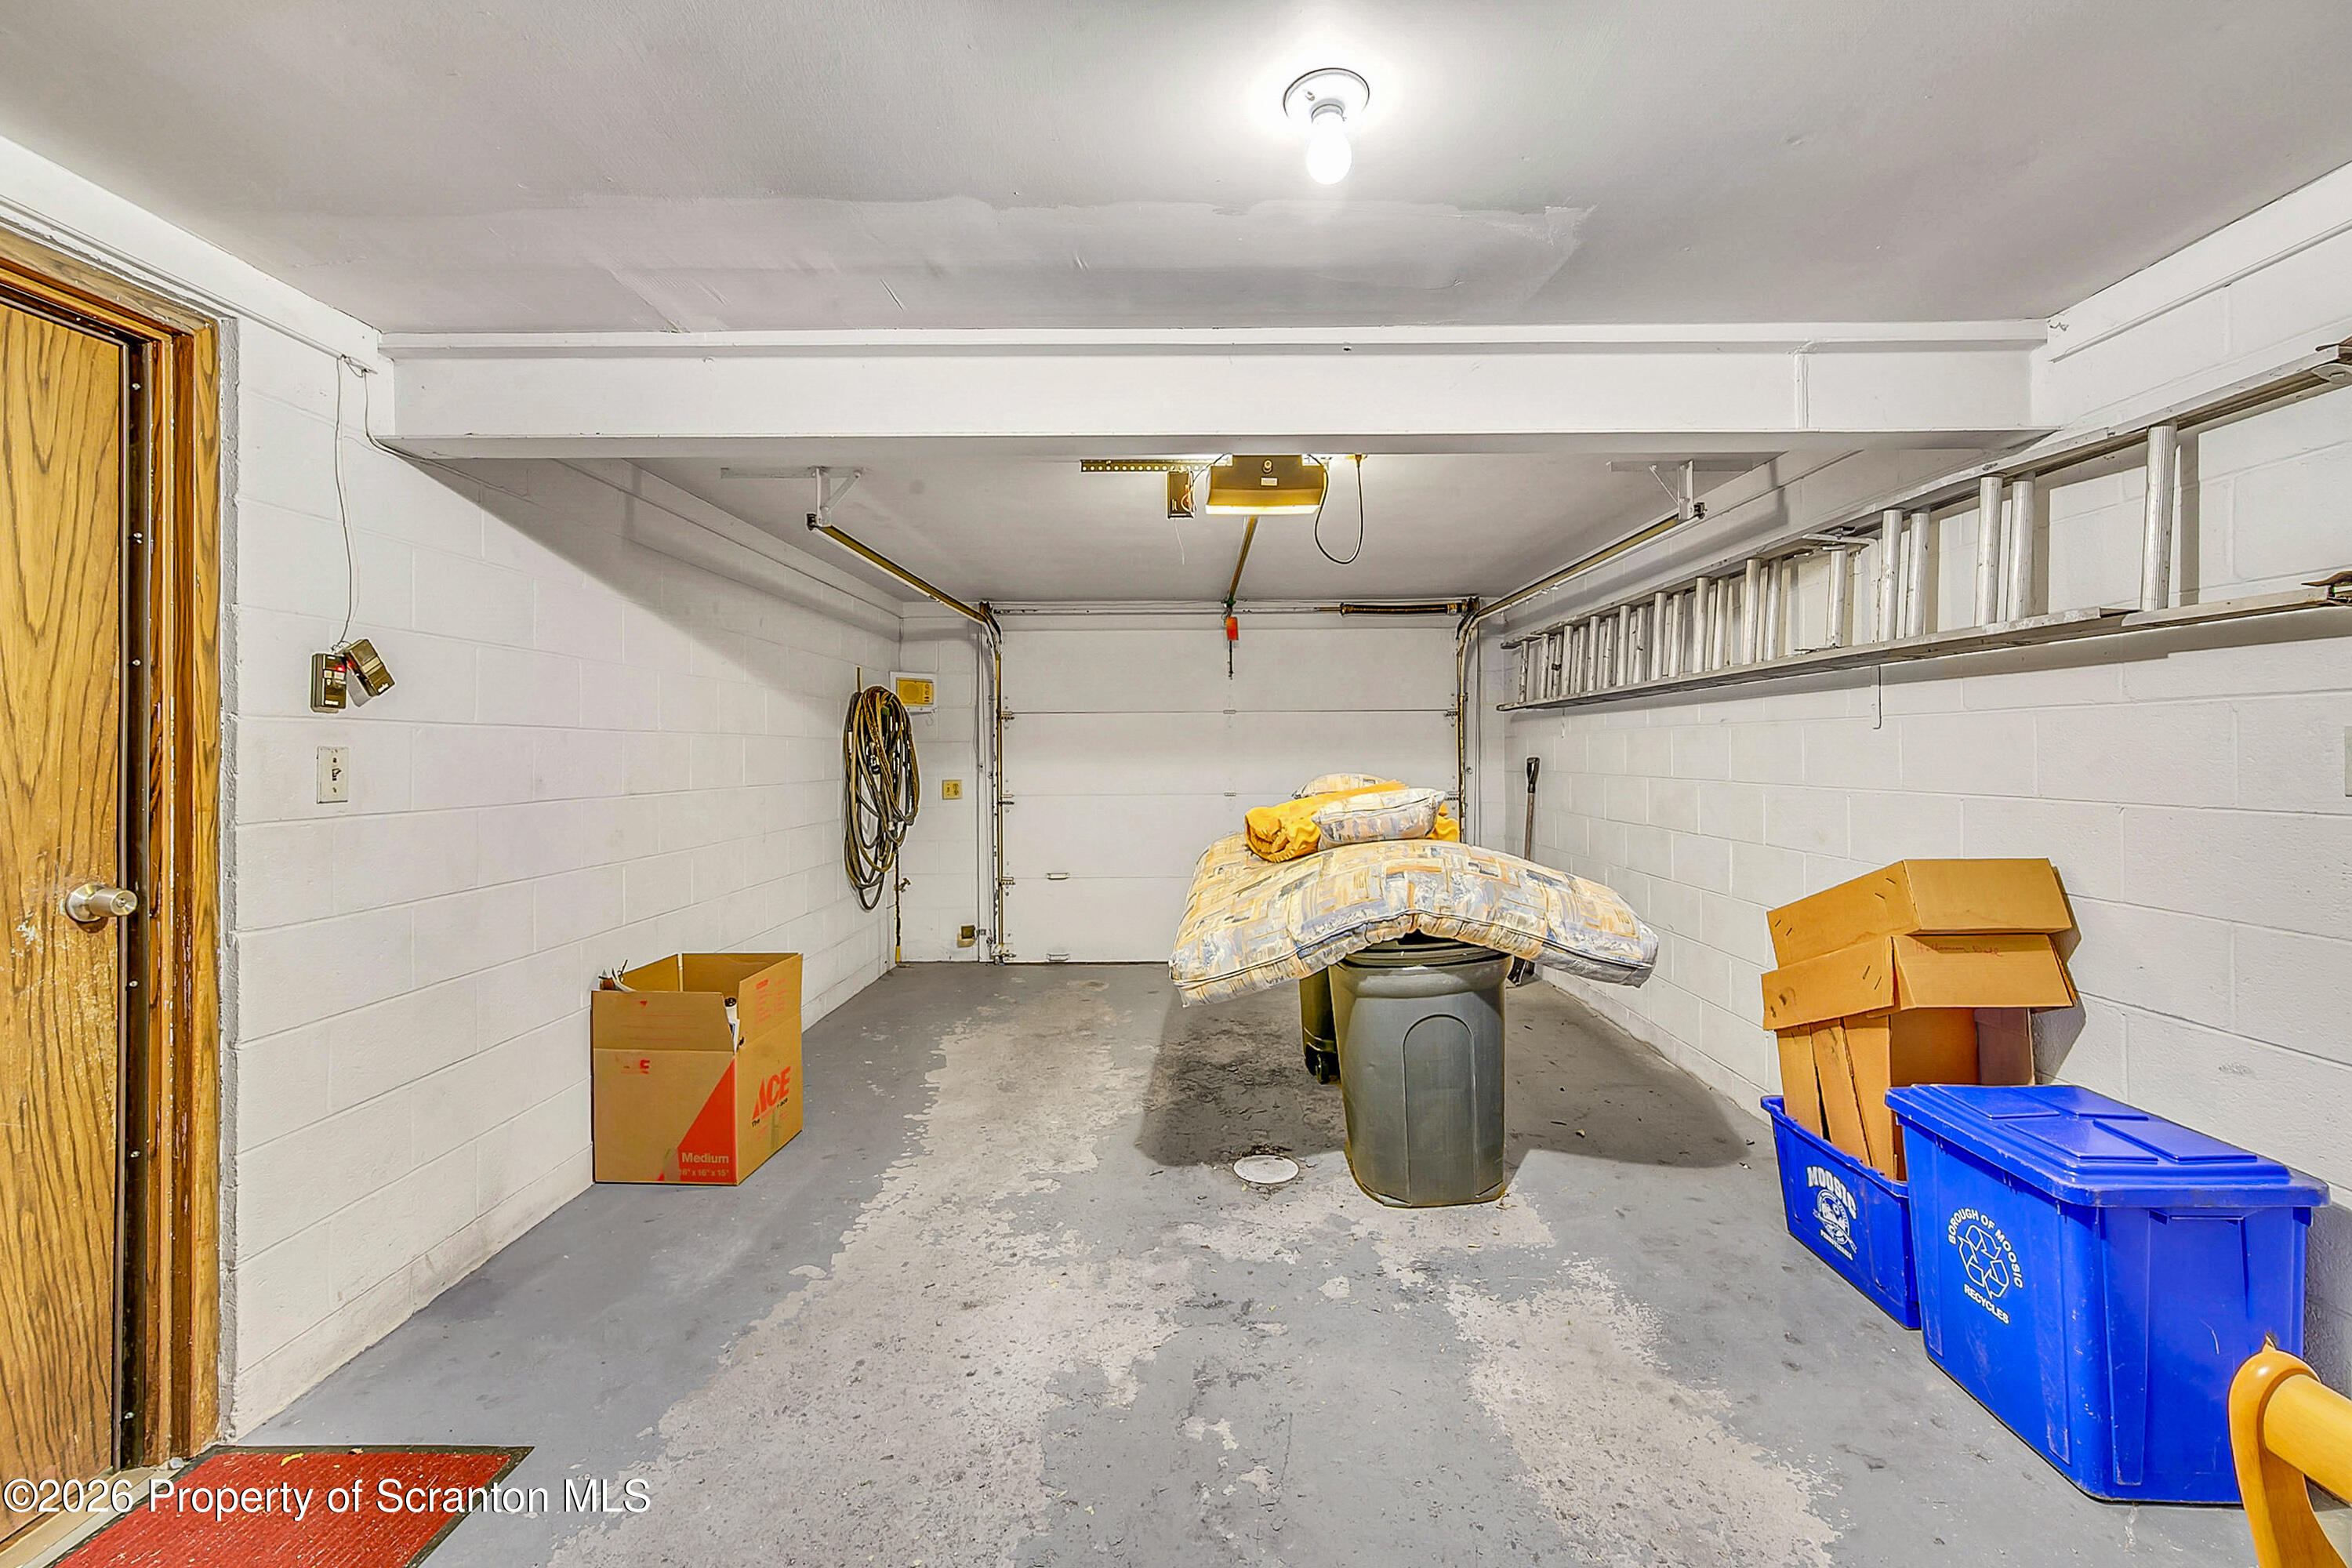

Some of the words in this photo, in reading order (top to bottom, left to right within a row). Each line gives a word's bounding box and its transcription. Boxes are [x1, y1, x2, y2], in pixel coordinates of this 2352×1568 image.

[751, 1065, 792, 1121] ACE
[681, 1152, 730, 1164] Medium
[1806, 1166, 1858, 1220] MOOSIC
[1947, 1207, 1980, 1246] BOROUGH
[1980, 1214, 1995, 1230] OF
[1994, 1229, 2024, 1289] MOOSIC
[1963, 1283, 2010, 1325] RECYCLES
